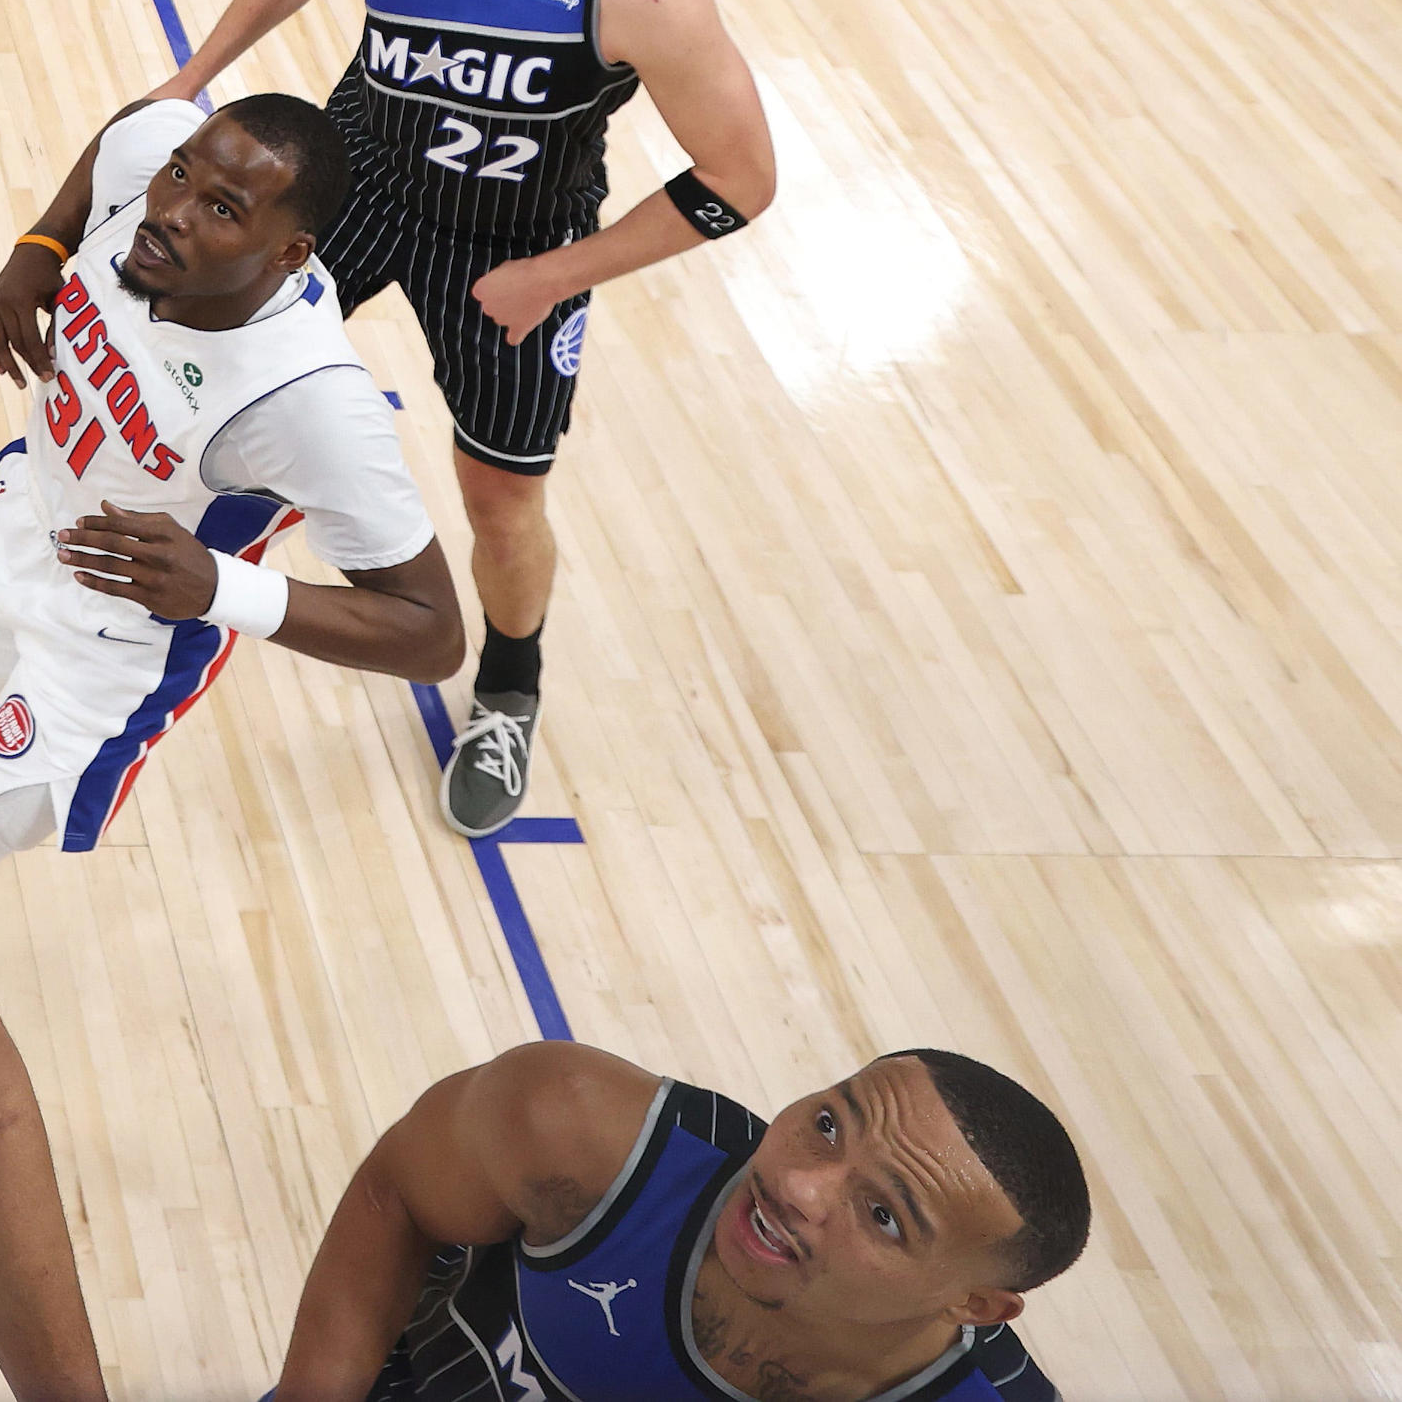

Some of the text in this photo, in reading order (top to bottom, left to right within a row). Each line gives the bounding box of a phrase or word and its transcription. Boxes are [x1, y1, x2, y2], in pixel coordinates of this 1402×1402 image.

[424, 116, 541, 183] 22
[694, 202, 736, 232] 22
[54, 271, 185, 481] PISTONS
[45, 369, 107, 481] 31
